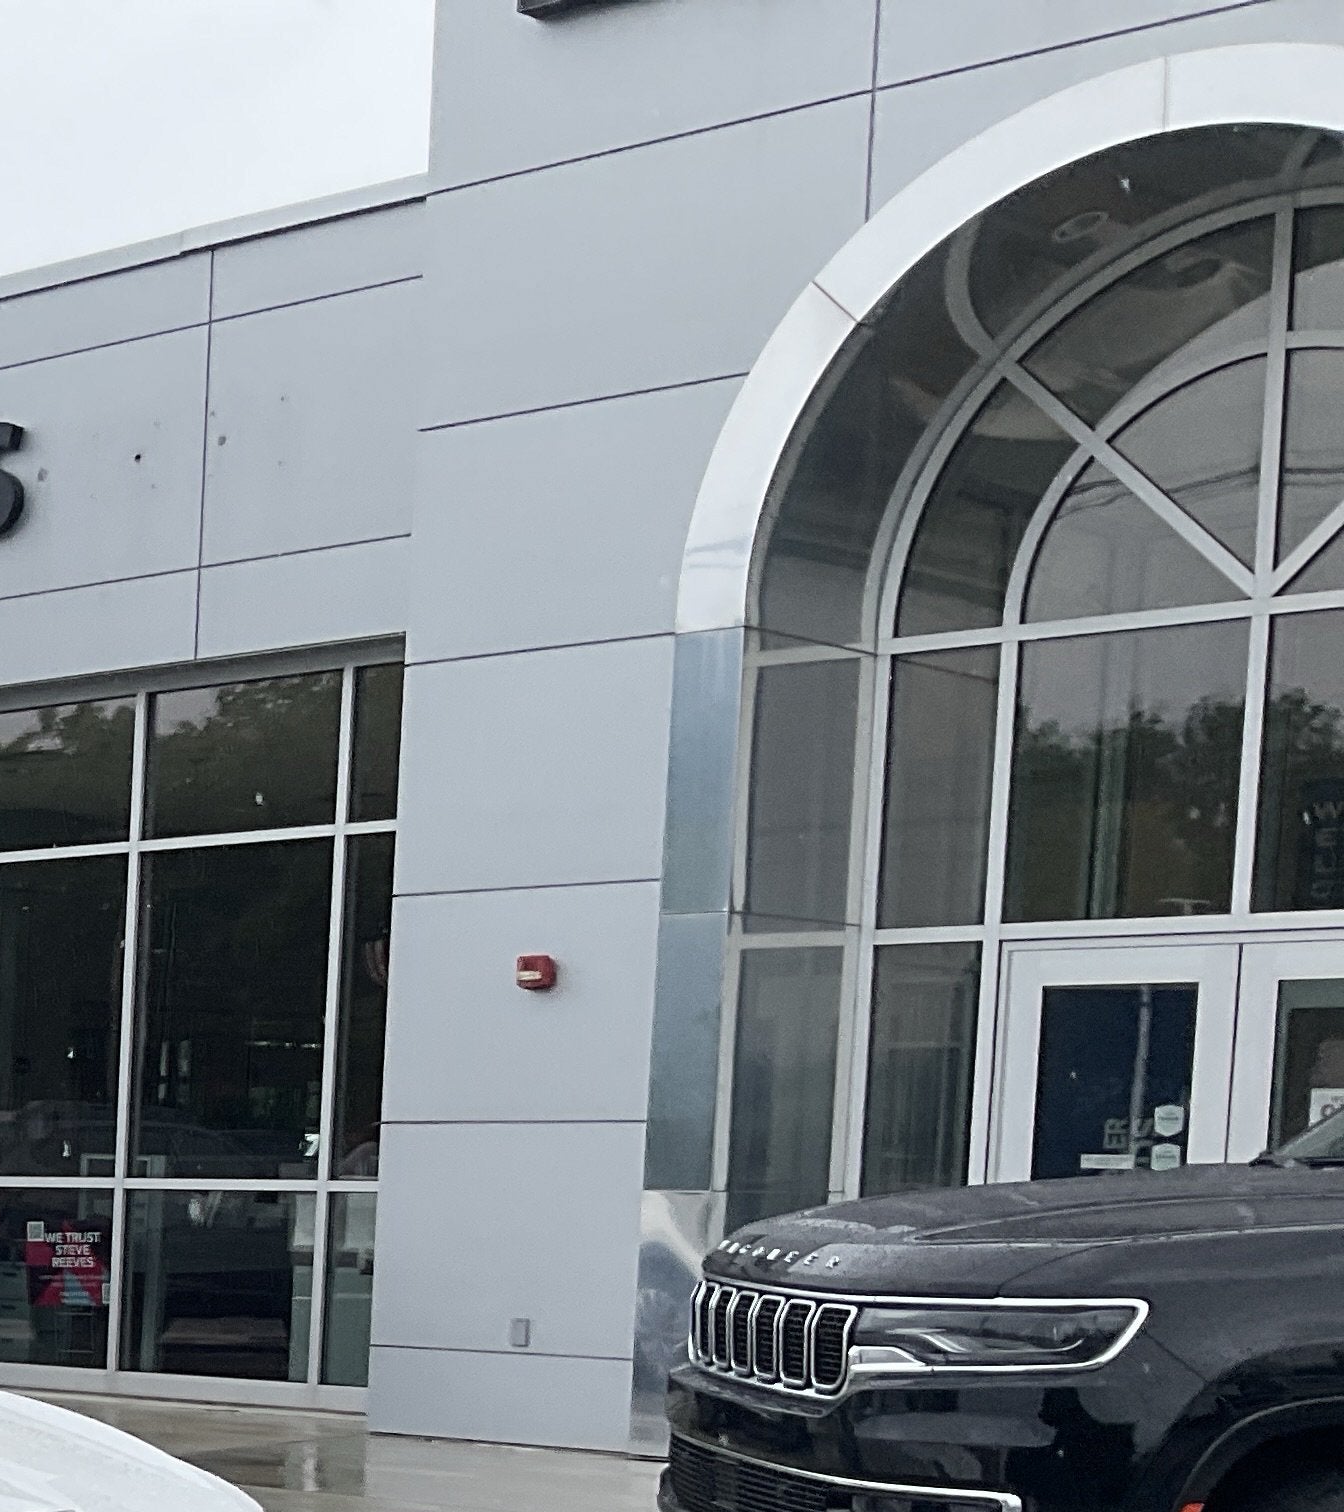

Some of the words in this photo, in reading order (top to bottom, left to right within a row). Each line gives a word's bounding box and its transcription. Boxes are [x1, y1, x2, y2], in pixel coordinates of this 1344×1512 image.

[45, 1232, 63, 1243] WE
[65, 1231, 102, 1243] TRUST
[55, 1244, 91, 1256] STEVE
[51, 1256, 95, 1268] REEVES
